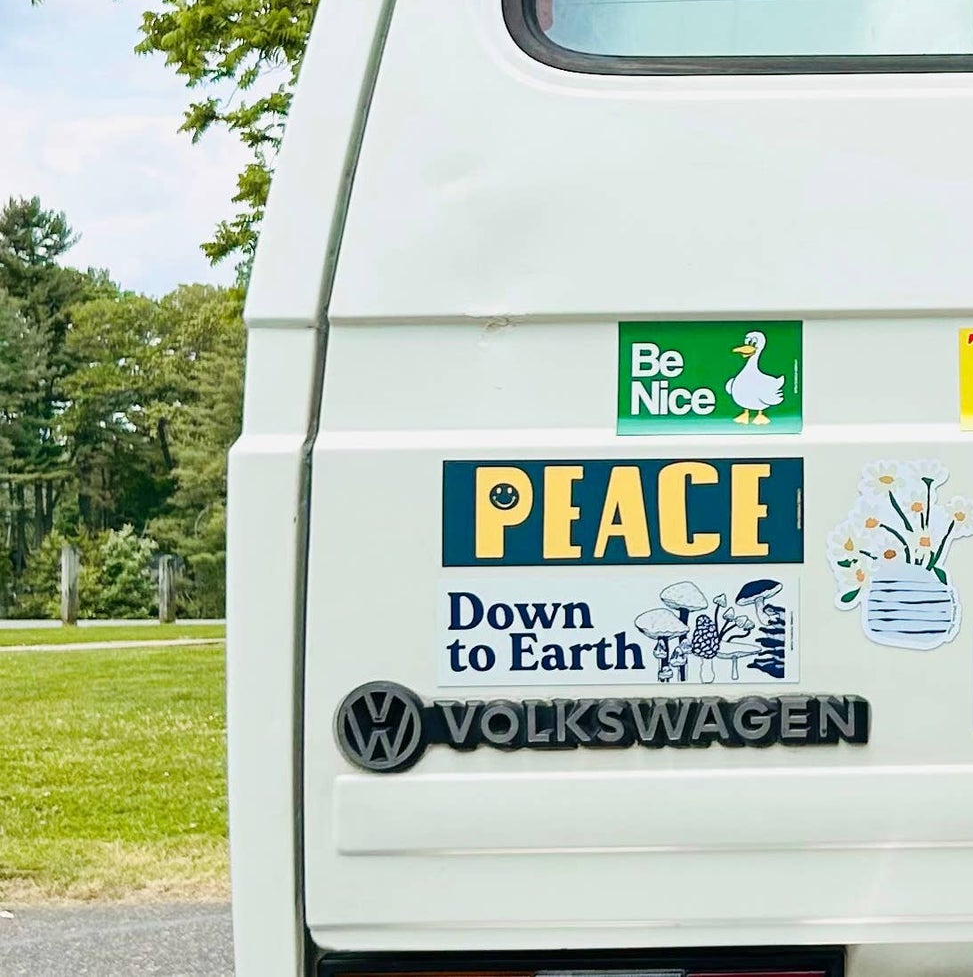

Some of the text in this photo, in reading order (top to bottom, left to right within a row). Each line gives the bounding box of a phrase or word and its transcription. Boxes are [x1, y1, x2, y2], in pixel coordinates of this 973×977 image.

[631, 342, 684, 378] Be
[630, 380, 716, 416] Nice
[475, 461, 771, 559] PEACE
[447, 591, 595, 631] Down
[446, 631, 646, 673] to Earth
[339, 682, 422, 770] VW
[436, 696, 860, 749] VOLKSWAGEN
